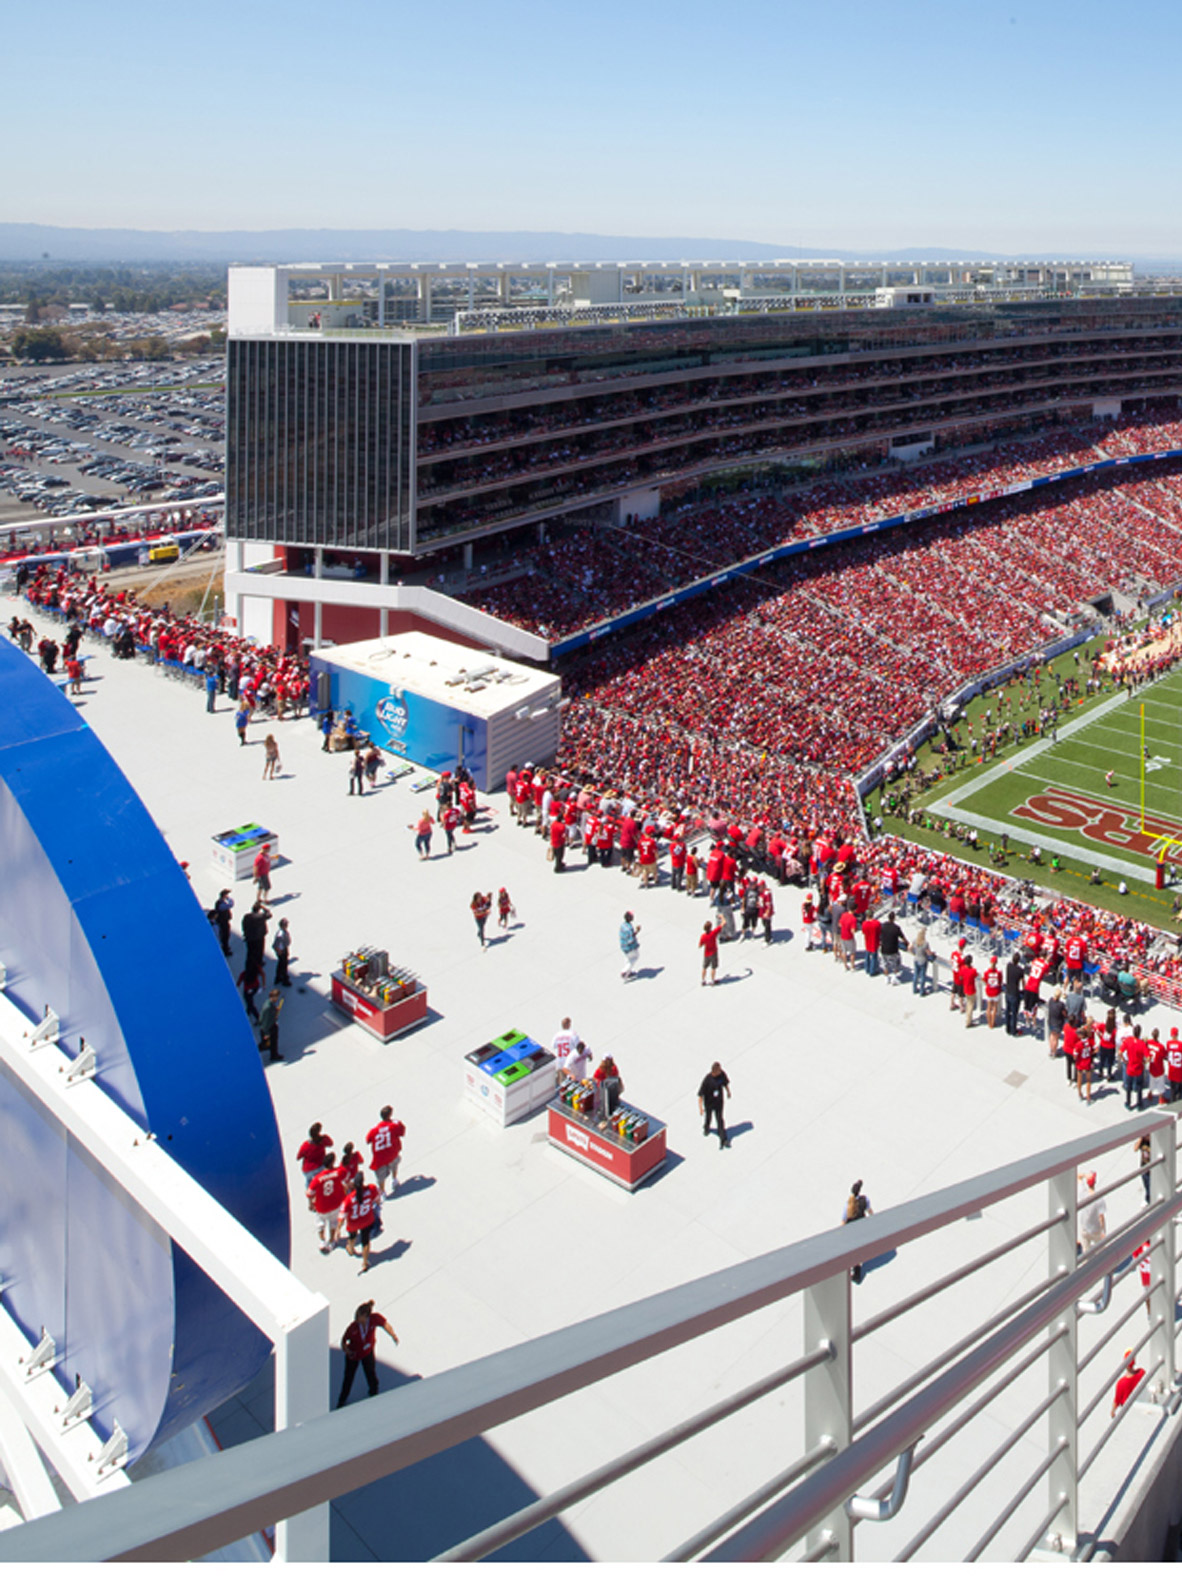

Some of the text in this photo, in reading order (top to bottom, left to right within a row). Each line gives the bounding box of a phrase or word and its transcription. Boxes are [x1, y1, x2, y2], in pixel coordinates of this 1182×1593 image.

[557, 1041, 571, 1058] 15
[374, 1131, 392, 1152] 21
[322, 1179, 334, 1196] 8
